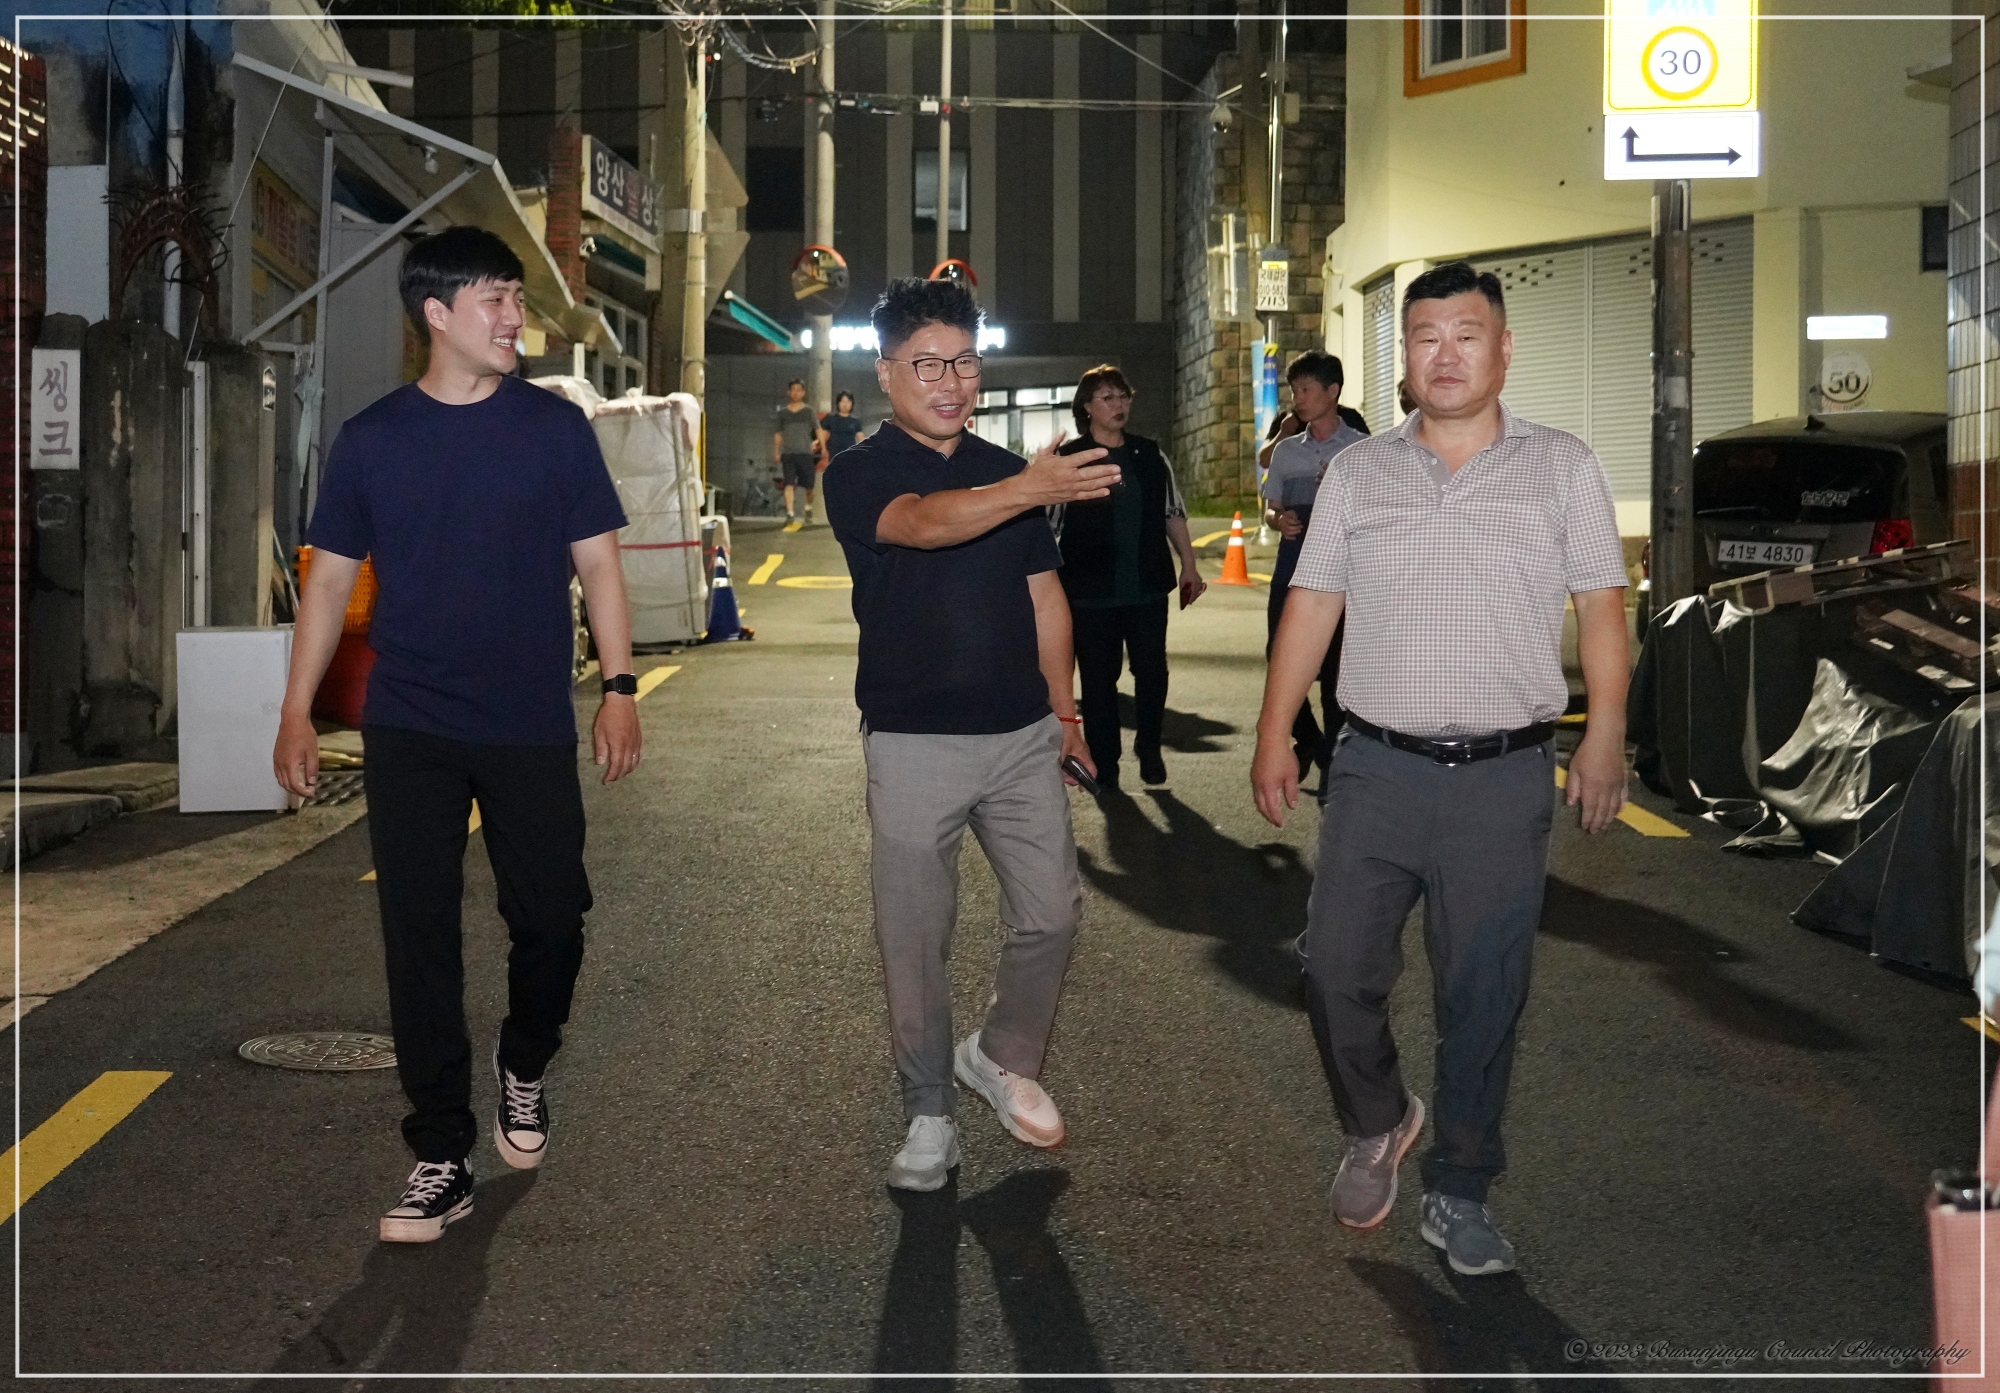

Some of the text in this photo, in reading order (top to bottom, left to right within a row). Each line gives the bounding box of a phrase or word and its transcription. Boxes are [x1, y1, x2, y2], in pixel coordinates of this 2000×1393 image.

[1659, 49, 1702, 76] 30
[1259, 296, 1287, 307] 7113
[1828, 371, 1860, 394] 50
[39, 361, 72, 456] 씽크
[1726, 544, 1804, 563] 41보 4830
